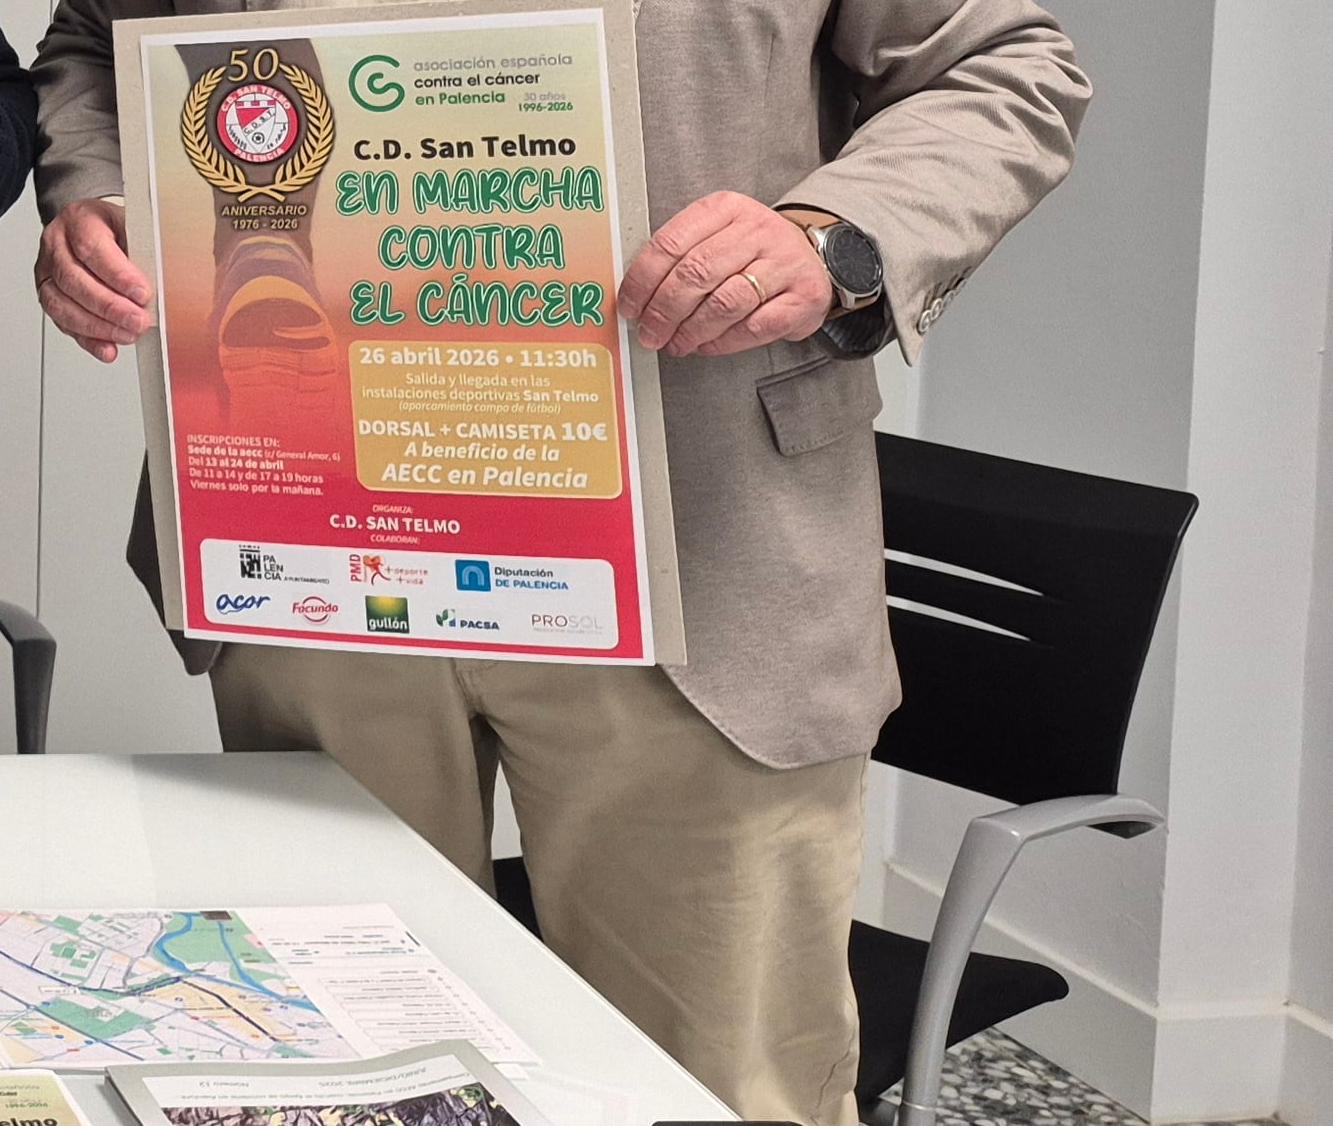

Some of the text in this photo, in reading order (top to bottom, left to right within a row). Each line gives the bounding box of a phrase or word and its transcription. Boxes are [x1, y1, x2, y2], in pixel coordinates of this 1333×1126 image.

[225, 46, 281, 82] 50
[412, 52, 573, 72] asociación española
[413, 71, 541, 89] contra el cáncer
[236, 84, 259, 95] SAN
[260, 84, 291, 110] TELMO
[414, 89, 505, 106] en Palencia
[523, 90, 566, 102] 30 años
[517, 101, 573, 113] 1996-2026
[234, 146, 286, 163] PALENCIA
[352, 132, 577, 161] C.D. San Telmo
[333, 164, 605, 216] EN MARCHA
[220, 204, 307, 216] ANIVERSARIO
[231, 219, 260, 229] 1976
[269, 218, 299, 229] 2026
[376, 222, 565, 270] CONTRA
[347, 273, 606, 326] EL CÁNCER
[358, 347, 597, 368] 26 abril 2026 11:30h
[404, 372, 550, 389] Salida y llegada en las
[361, 386, 599, 403] instalaciones deportivas San Telmo
[473, 403, 510, 414] campo
[510, 402, 525, 413] de
[525, 402, 562, 415] fútbol)
[357, 419, 608, 442] DORSAL + CAMISETA 10€
[186, 434, 281, 448] INSCRIPCIONES EN:
[187, 444, 212, 455] Sede
[213, 446, 226, 456] de
[227, 446, 238, 456] la
[239, 448, 263, 457] aecc
[403, 440, 560, 462] A beneficio de la
[187, 456, 284, 470] Del 13 al 24 de abril
[379, 462, 588, 489] AECC en Palencia
[328, 513, 462, 534] C.D. SAN TELMO
[348, 553, 363, 582] PMD
[493, 566, 554, 579] Diputación
[494, 578, 569, 591] DE PALENCIA
[214, 591, 272, 614] acor
[291, 601, 339, 616] Facundo
[367, 614, 408, 632] gullón
[459, 619, 500, 630] PACSA
[530, 613, 604, 630] PROSOL
